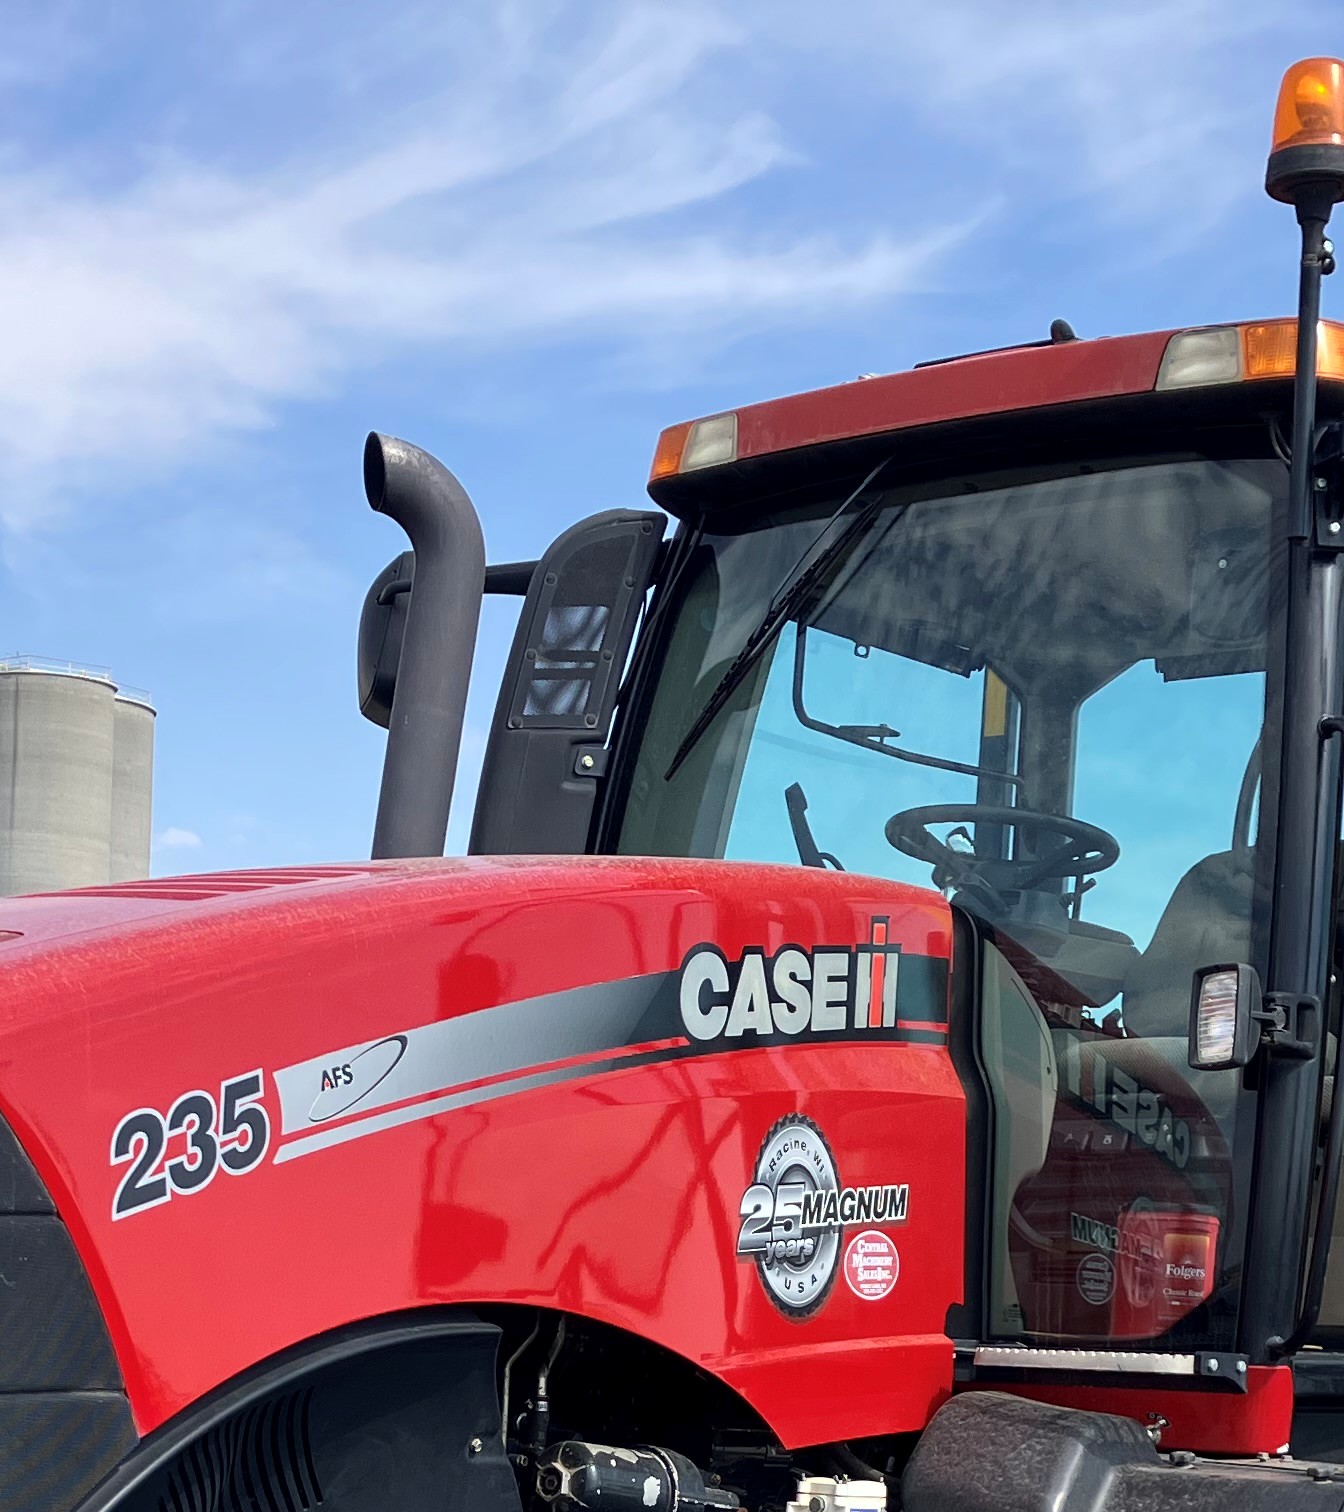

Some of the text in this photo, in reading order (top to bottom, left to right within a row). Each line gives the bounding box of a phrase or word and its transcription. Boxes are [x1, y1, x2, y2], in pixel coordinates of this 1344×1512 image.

[680, 950, 850, 1040] CASE
[321, 1063, 354, 1092] AFS
[110, 1068, 270, 1222] 235
[768, 1138, 811, 1173] Racine,
[737, 1184, 806, 1254] 25
[800, 1184, 909, 1228] MAGNUM
[766, 1237, 814, 1263] years
[1166, 1263, 1206, 1279] Folgers
